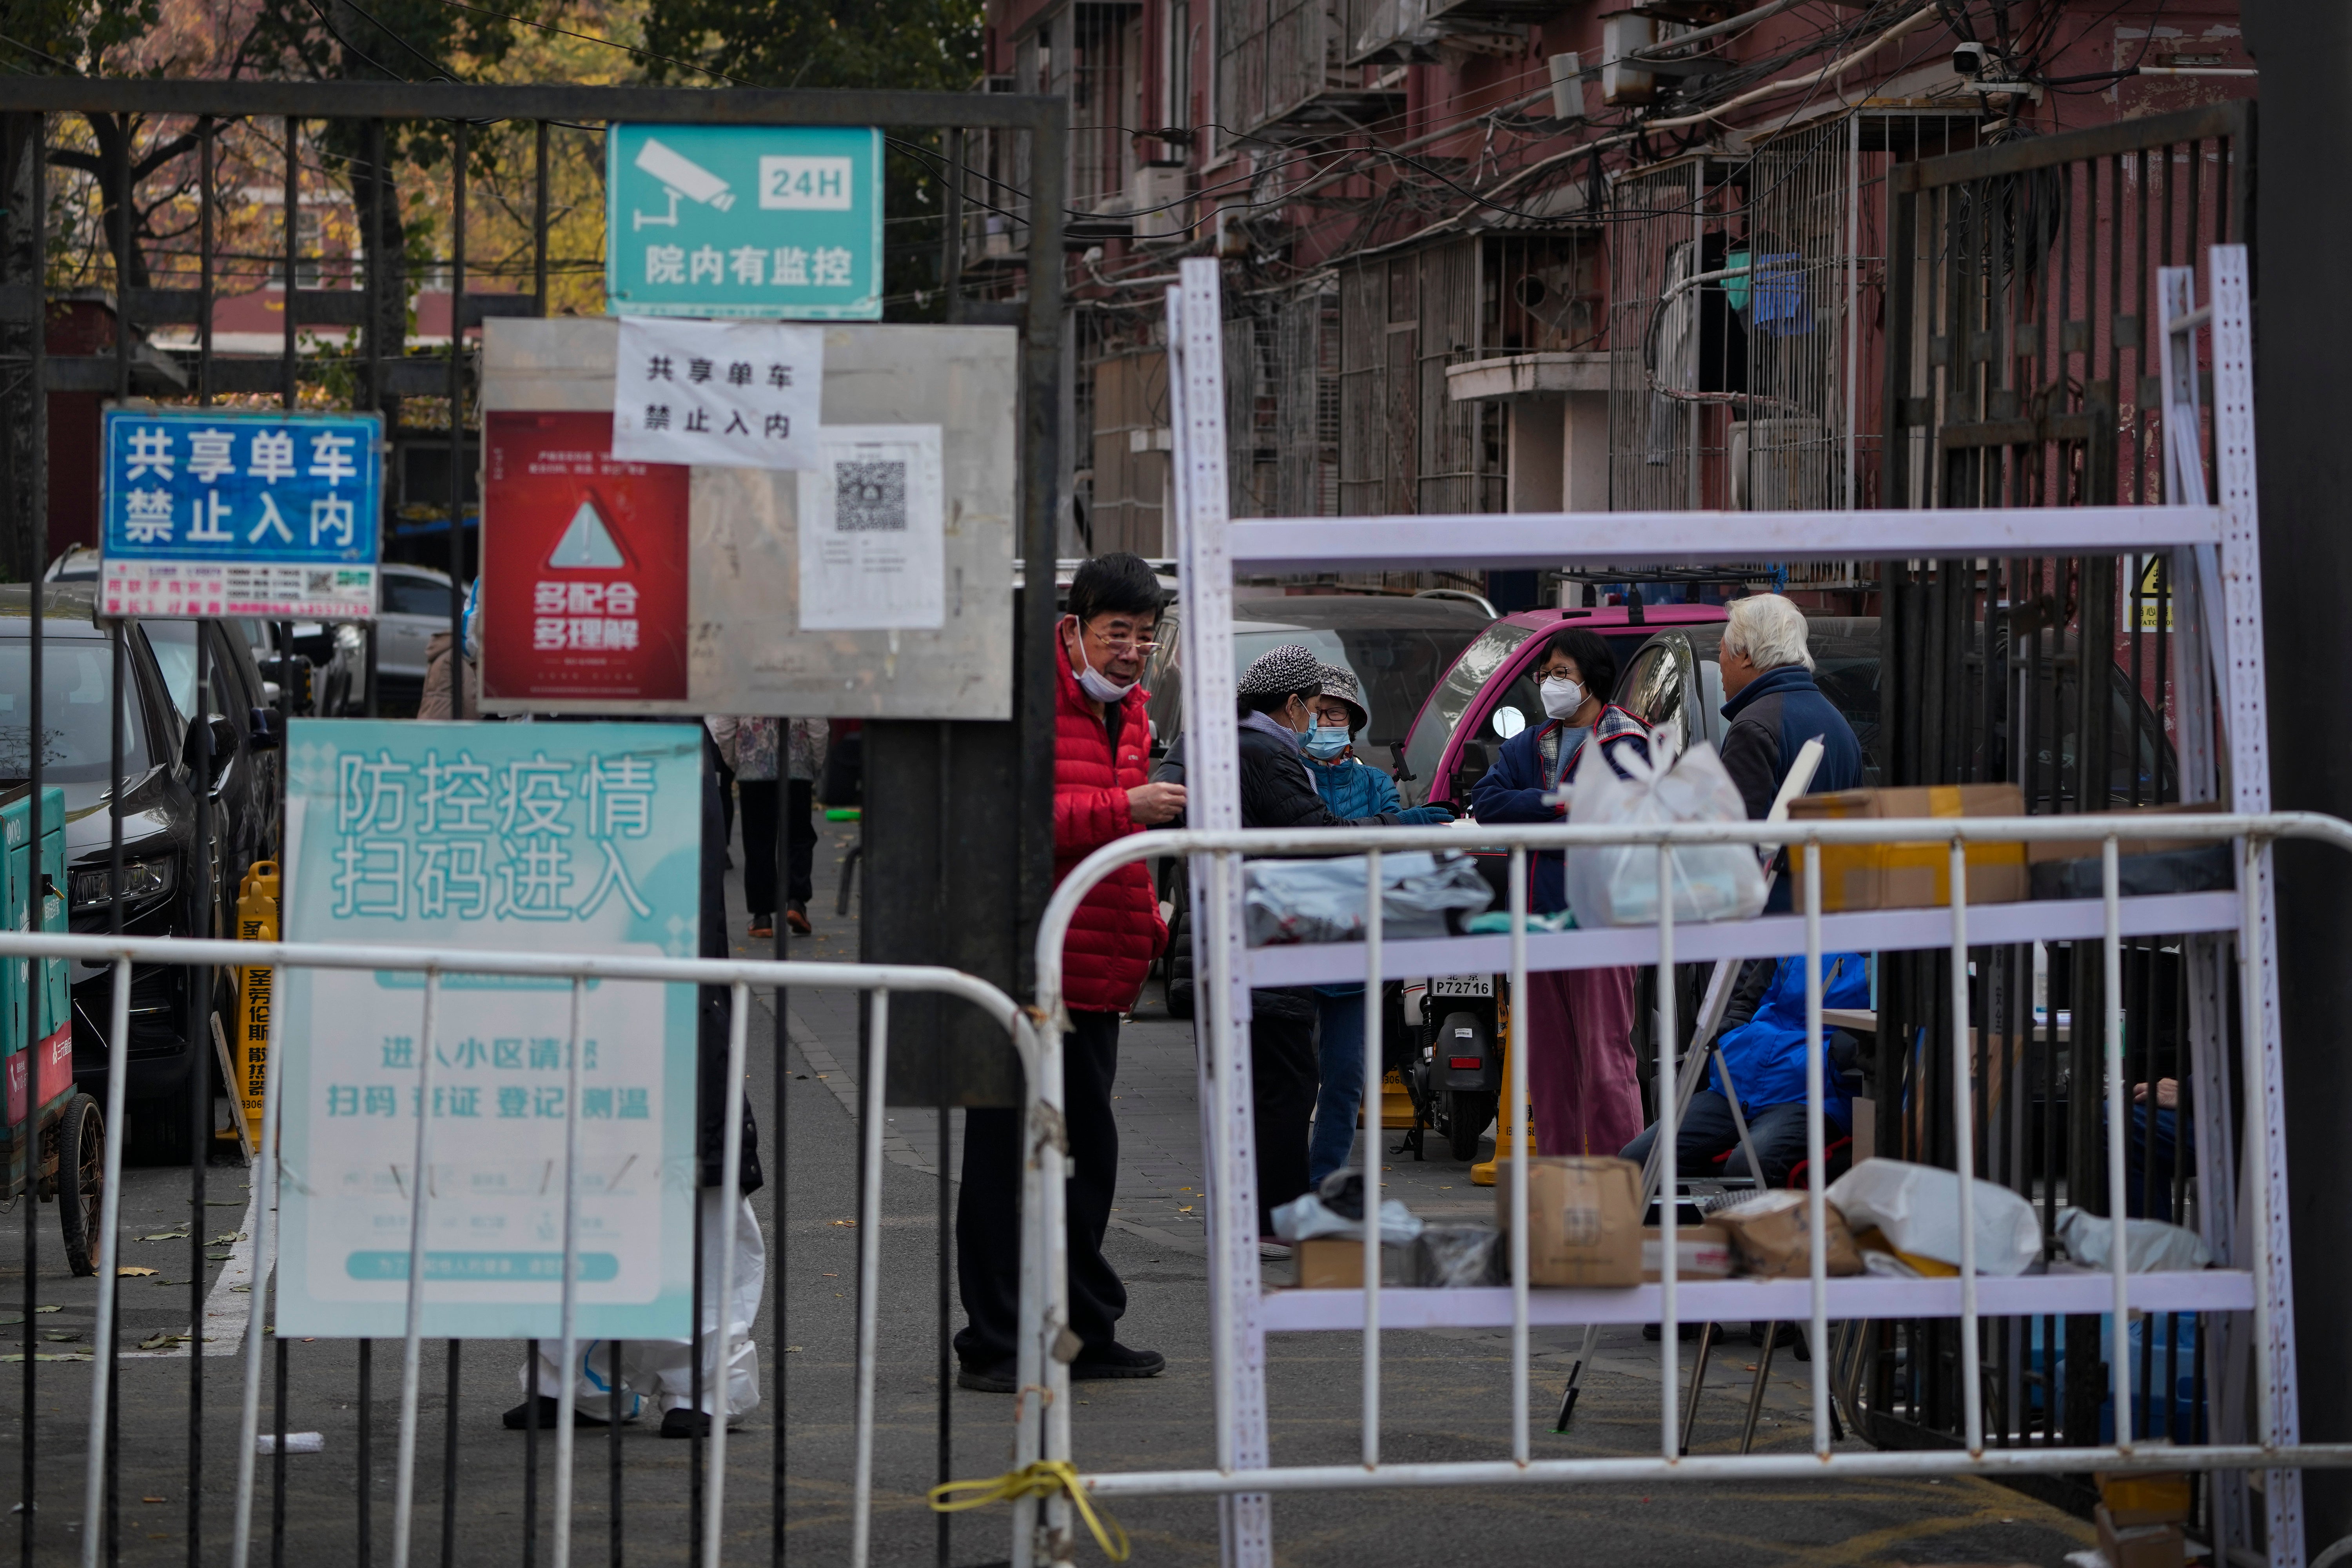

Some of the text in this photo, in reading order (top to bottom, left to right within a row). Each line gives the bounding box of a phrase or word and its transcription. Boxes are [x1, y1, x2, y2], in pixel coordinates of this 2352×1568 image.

[772, 171, 841, 198] 24H
[646, 245, 853, 286] 院内有监控
[648, 356, 794, 389] 共享单车
[645, 405, 790, 438] 禁止入内
[125, 427, 356, 486] 共享单车
[124, 487, 354, 546] 禁止入内
[534, 581, 639, 614] 多配合
[534, 618, 639, 651] 多理解
[337, 750, 657, 838] 防控疫情
[332, 836, 652, 919] 扫码进入
[1437, 982, 1488, 994] P72716
[57, 1036, 71, 1060] 三元食品
[327, 1085, 396, 1118] 扫码
[495, 1086, 564, 1120] 登记
[581, 1088, 650, 1120] 测温
